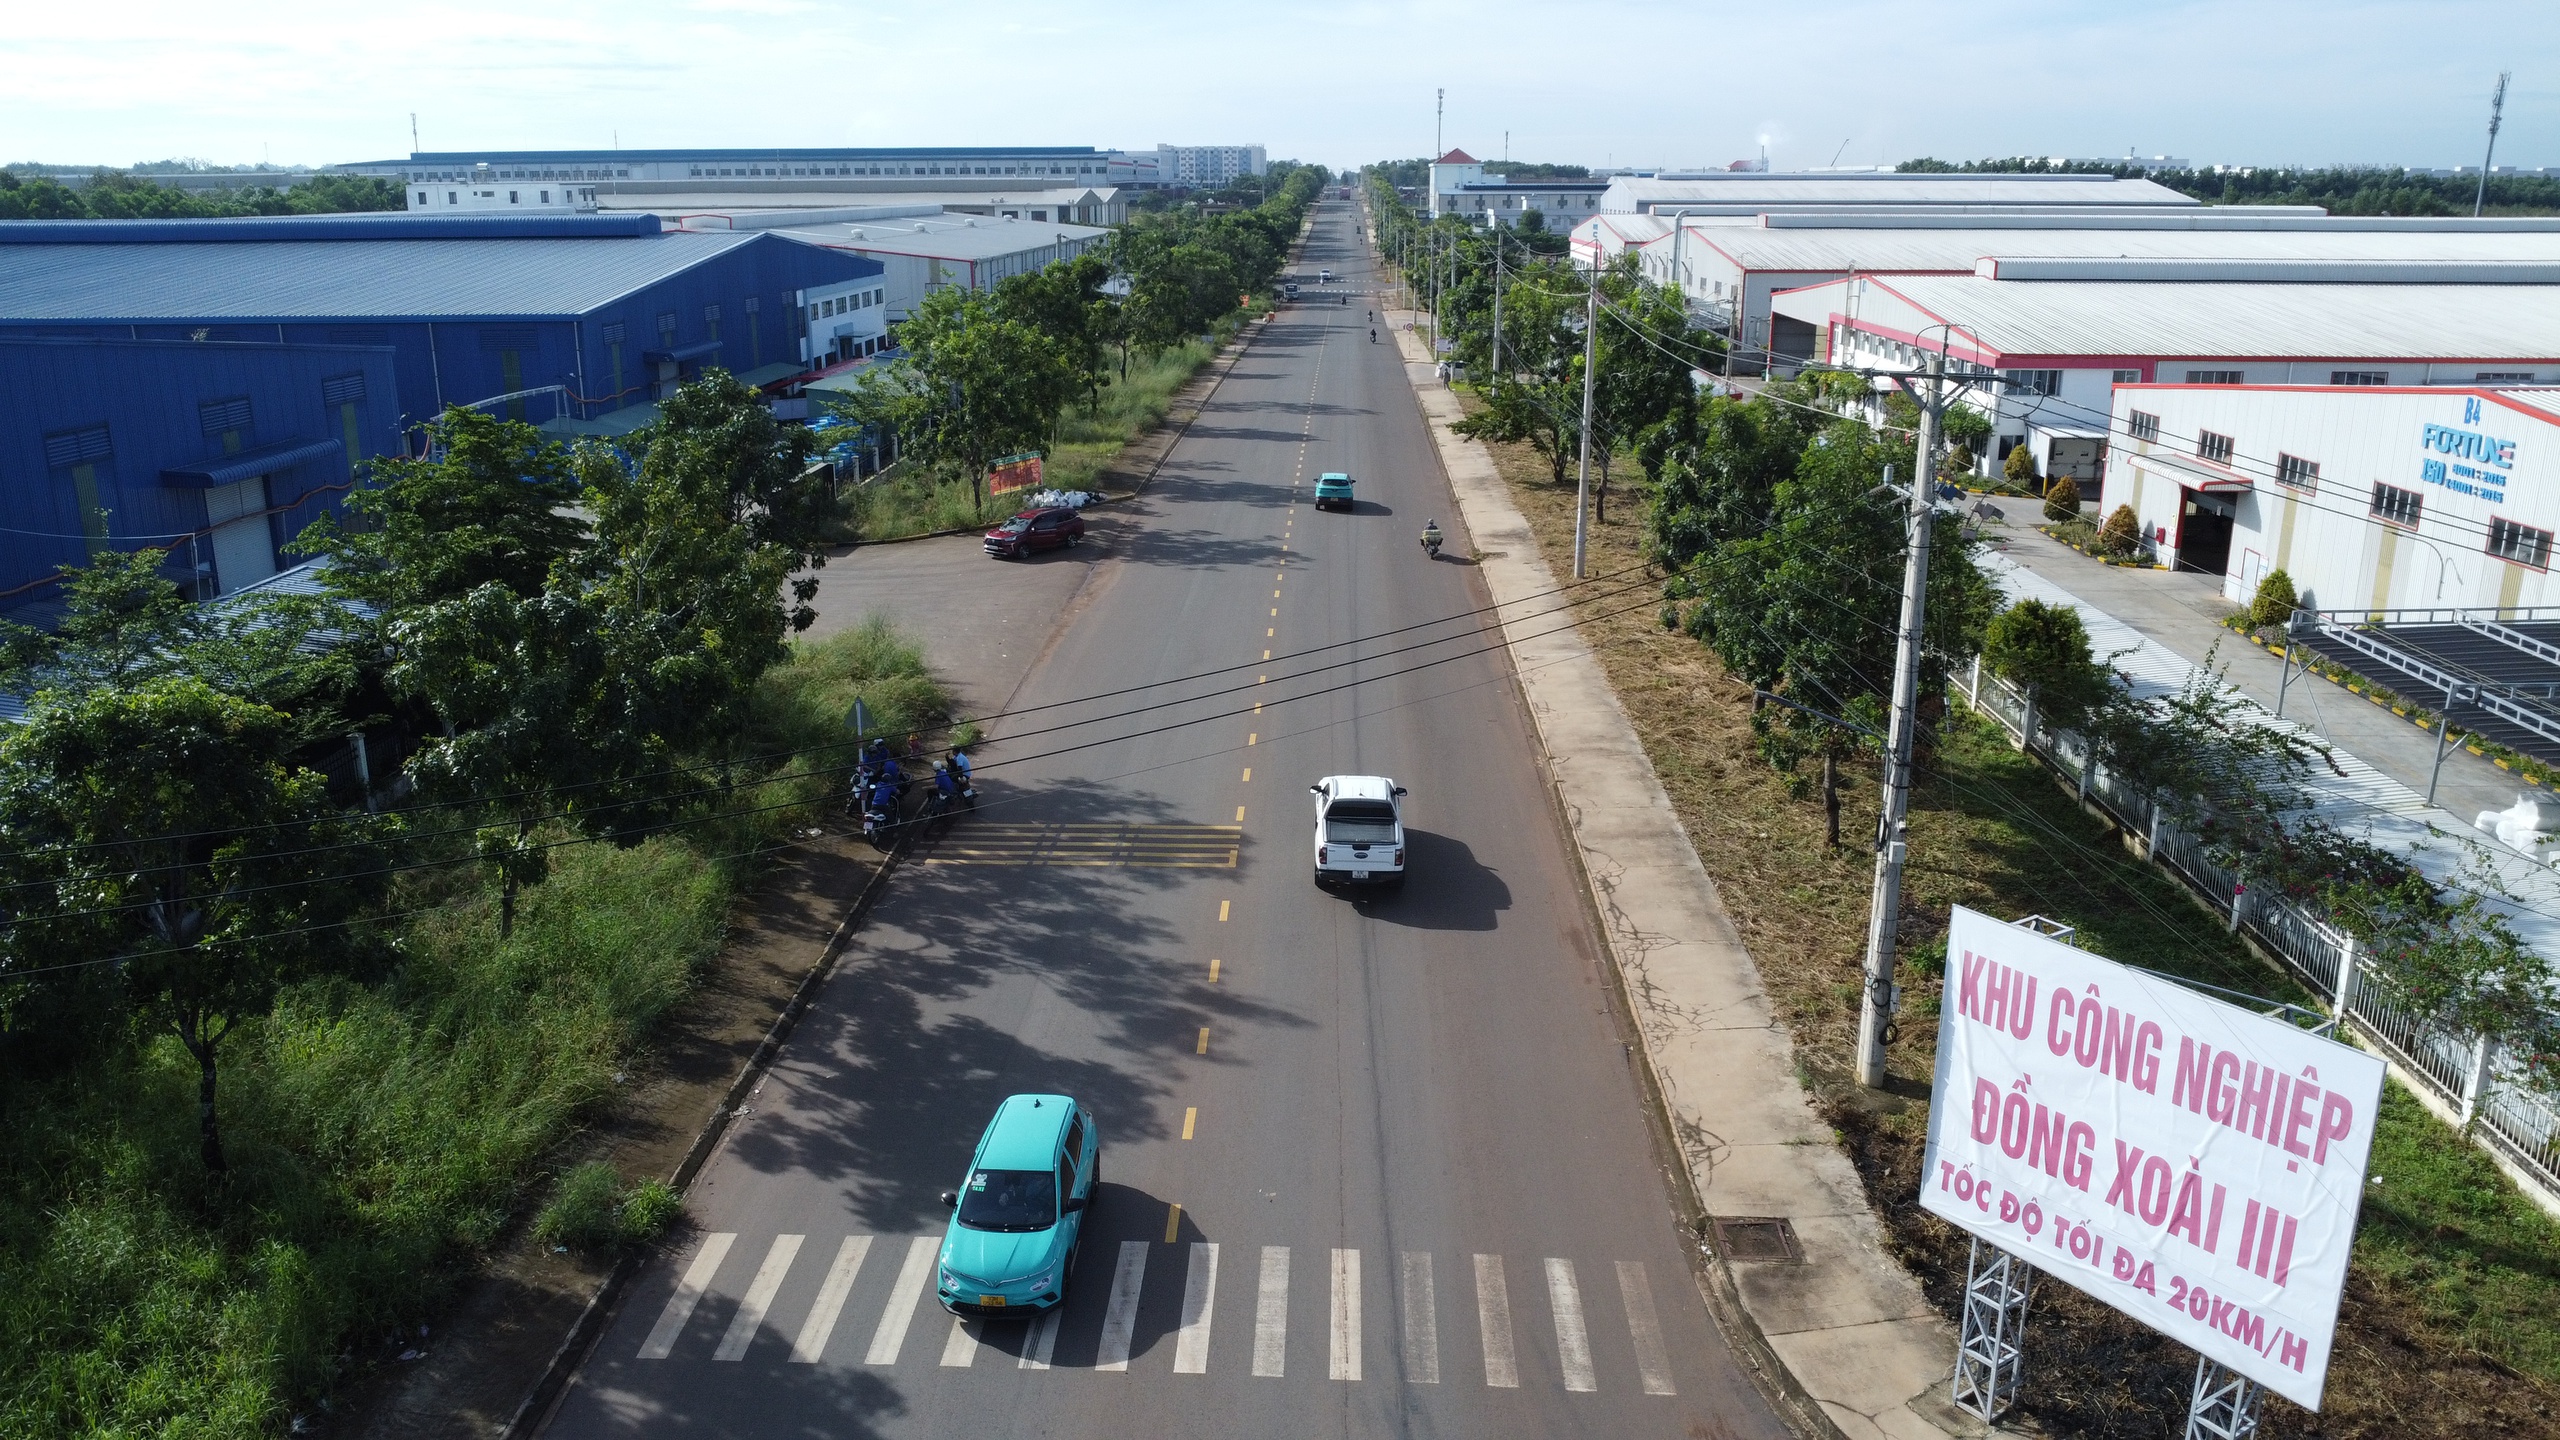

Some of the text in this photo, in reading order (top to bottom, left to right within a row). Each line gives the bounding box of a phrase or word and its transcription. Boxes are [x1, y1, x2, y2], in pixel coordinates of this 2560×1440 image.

[2421, 458, 2446, 486] ISO
[2422, 423, 2516, 470] FORTUNE
[2464, 397, 2481, 426] B4
[1958, 950, 2353, 1173] KHU CÔNG NGHIỆP
[1970, 1072, 2298, 1288] ĐỒNG XOÀI III
[1940, 1160, 2308, 1375] TỐC ĐỘ TỐI ĐA 20KM/H
